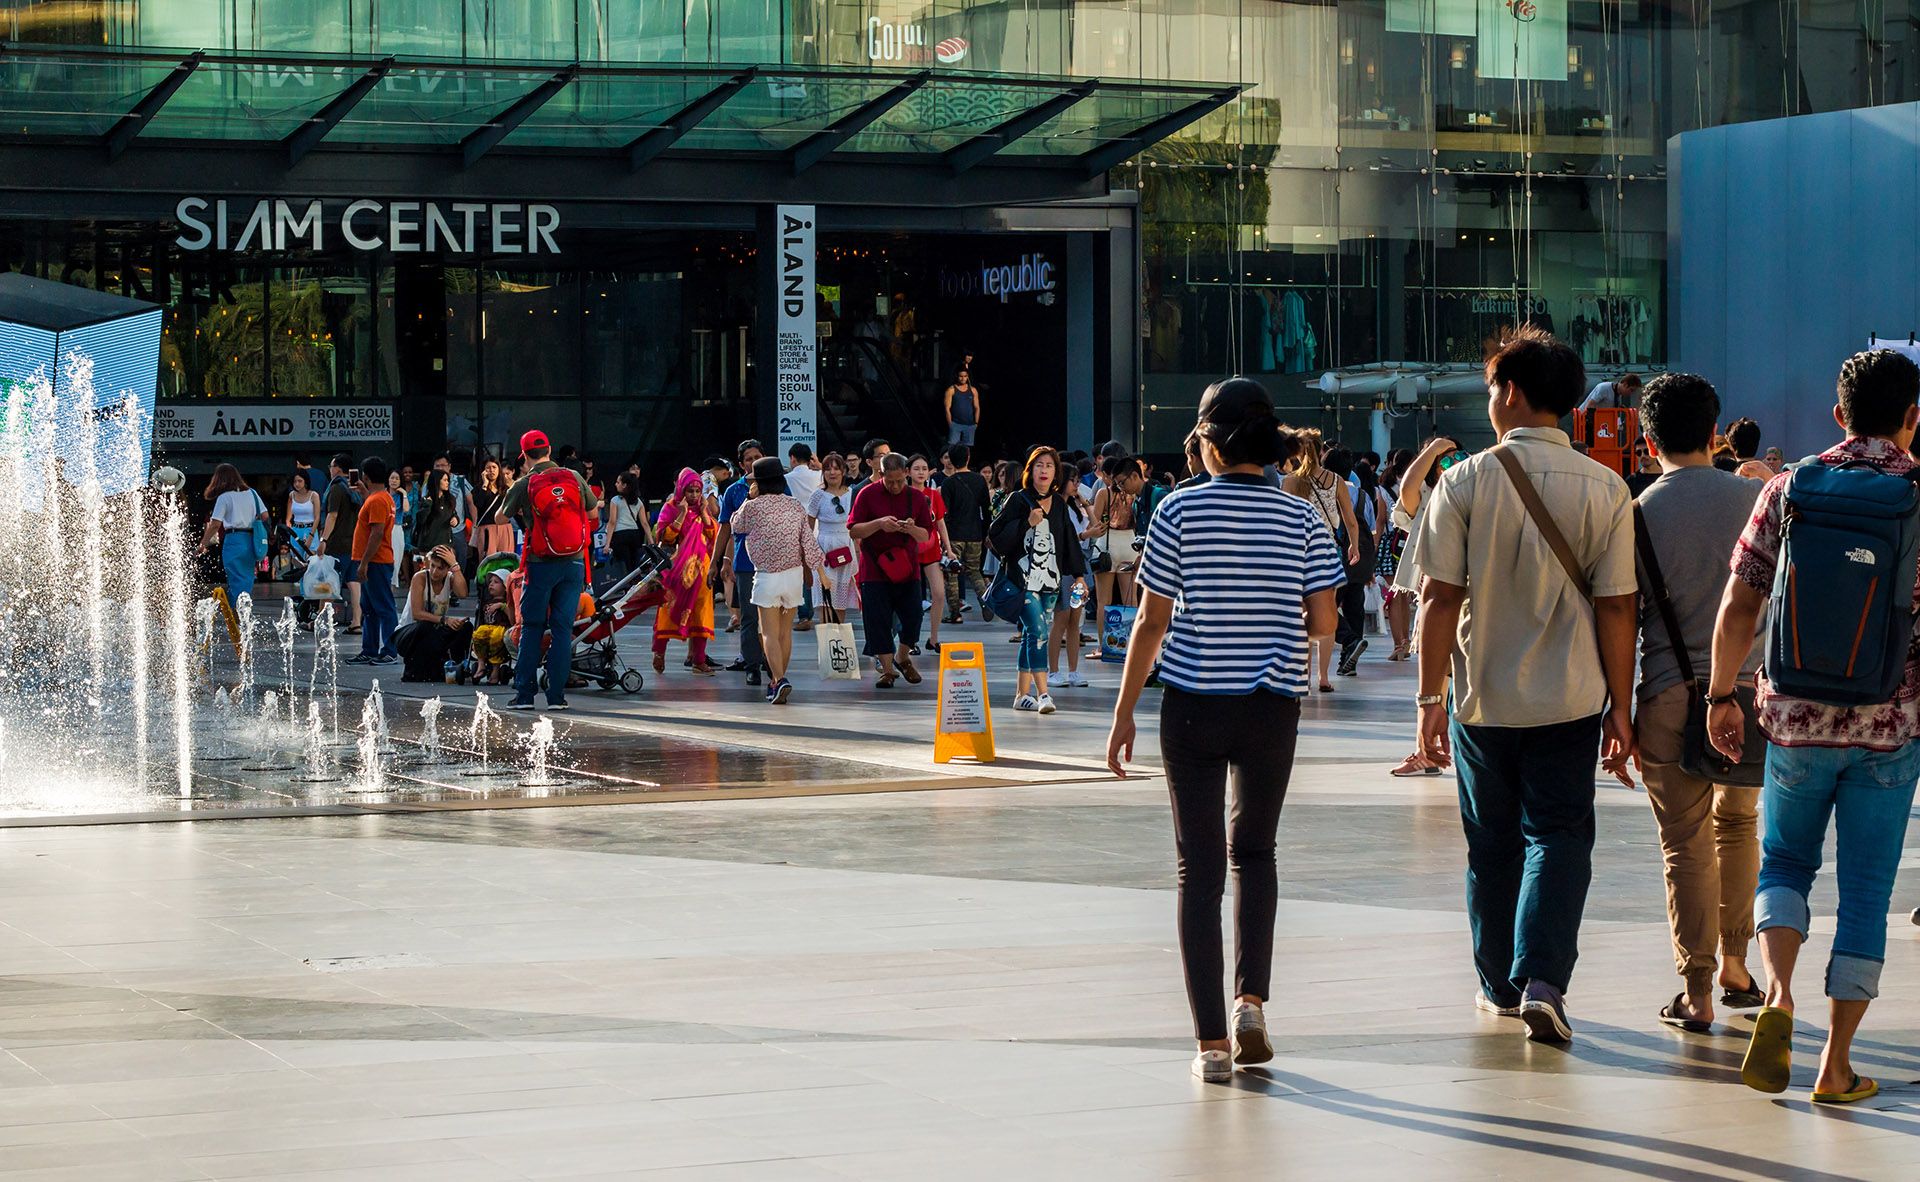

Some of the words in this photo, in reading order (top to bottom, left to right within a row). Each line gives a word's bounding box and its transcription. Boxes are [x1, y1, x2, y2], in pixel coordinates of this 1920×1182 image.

[175, 197, 323, 252] SIAM
[341, 199, 562, 254] CENTER
[779, 373, 810, 382] FROM
[779, 383, 815, 392] SEOUL
[779, 393, 794, 402] TO
[779, 402, 802, 411] BKK
[309, 408, 346, 418] FROM
[349, 408, 391, 418] SEOUL
[159, 419, 195, 428] STORE
[211, 410, 294, 436] ÅLAND
[309, 419, 327, 429] TO
[329, 419, 390, 429] BANGKOK
[780, 417, 802, 433] 2nd
[158, 429, 194, 438] SPACE
[360, 429, 391, 437] CENTER
